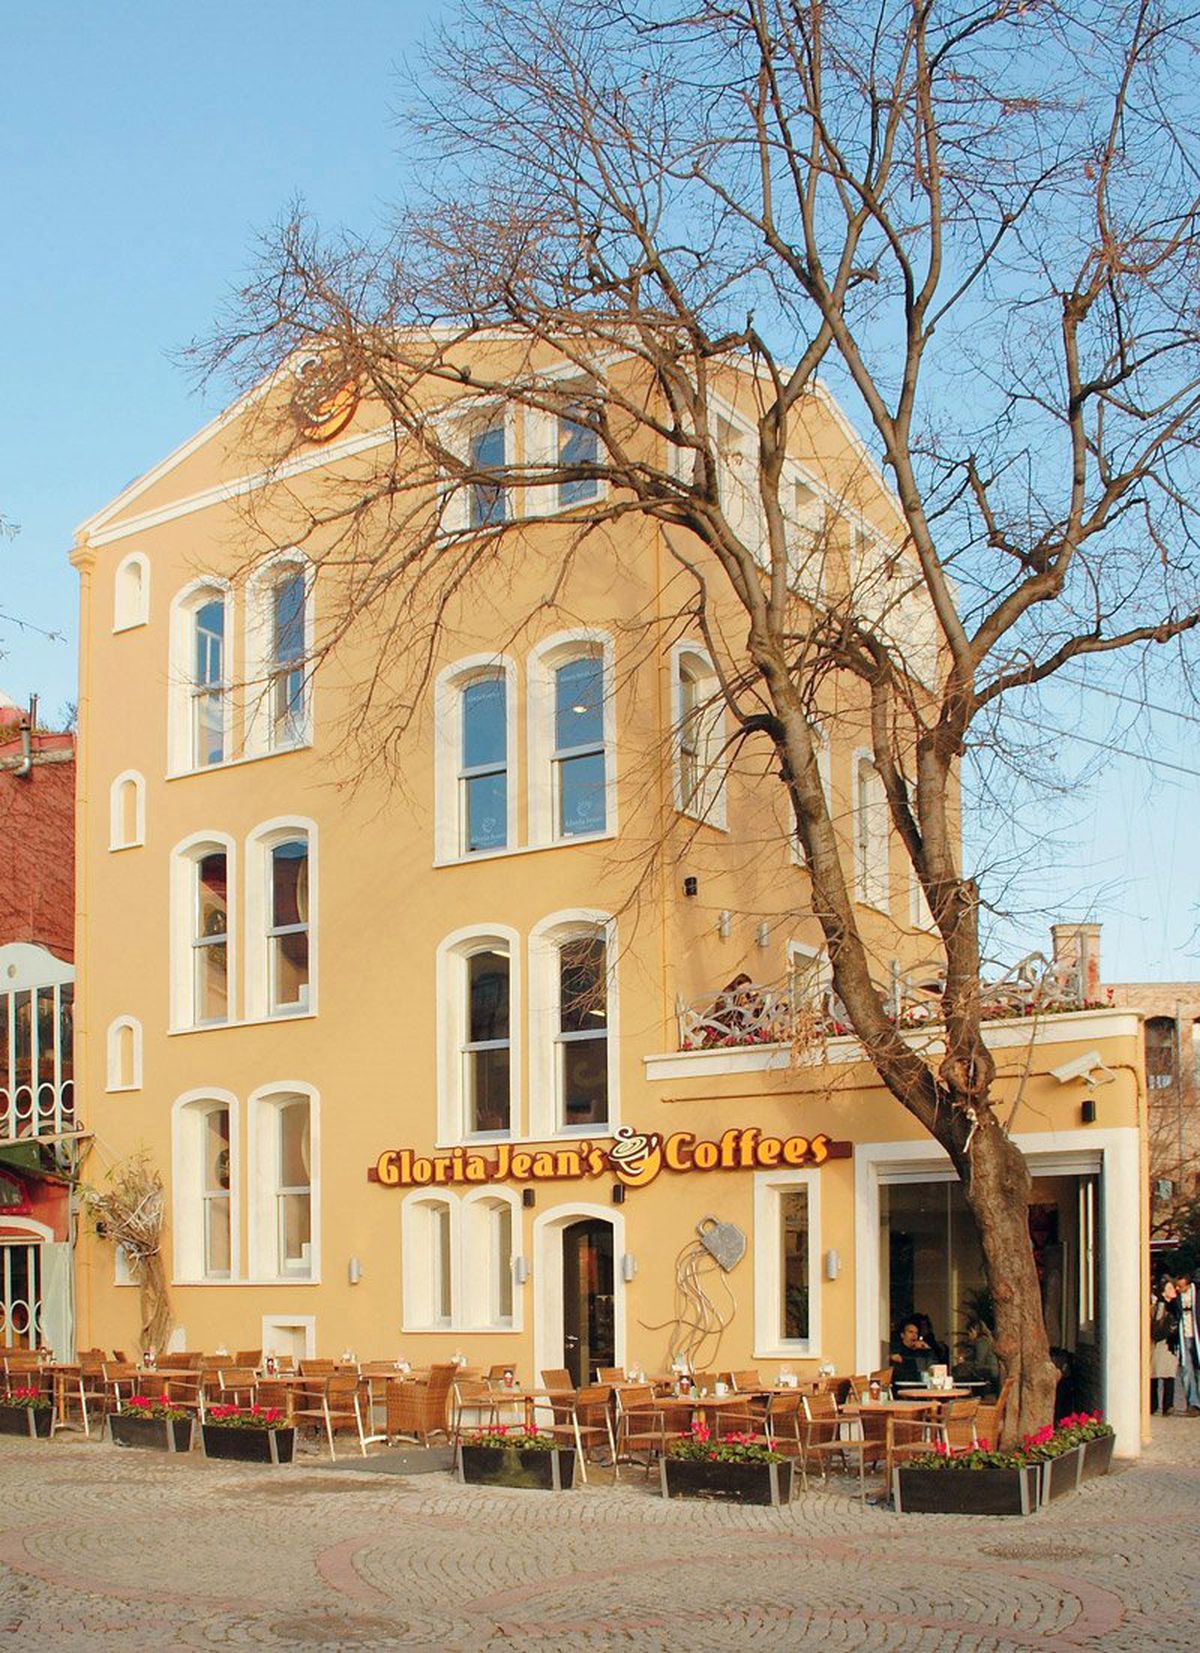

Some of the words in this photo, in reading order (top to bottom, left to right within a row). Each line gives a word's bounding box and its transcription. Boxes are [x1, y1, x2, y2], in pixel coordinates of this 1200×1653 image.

[378, 1148, 486, 1184] Gloria
[494, 1142, 604, 1179] Jean's
[665, 1129, 828, 1170] Coffees
